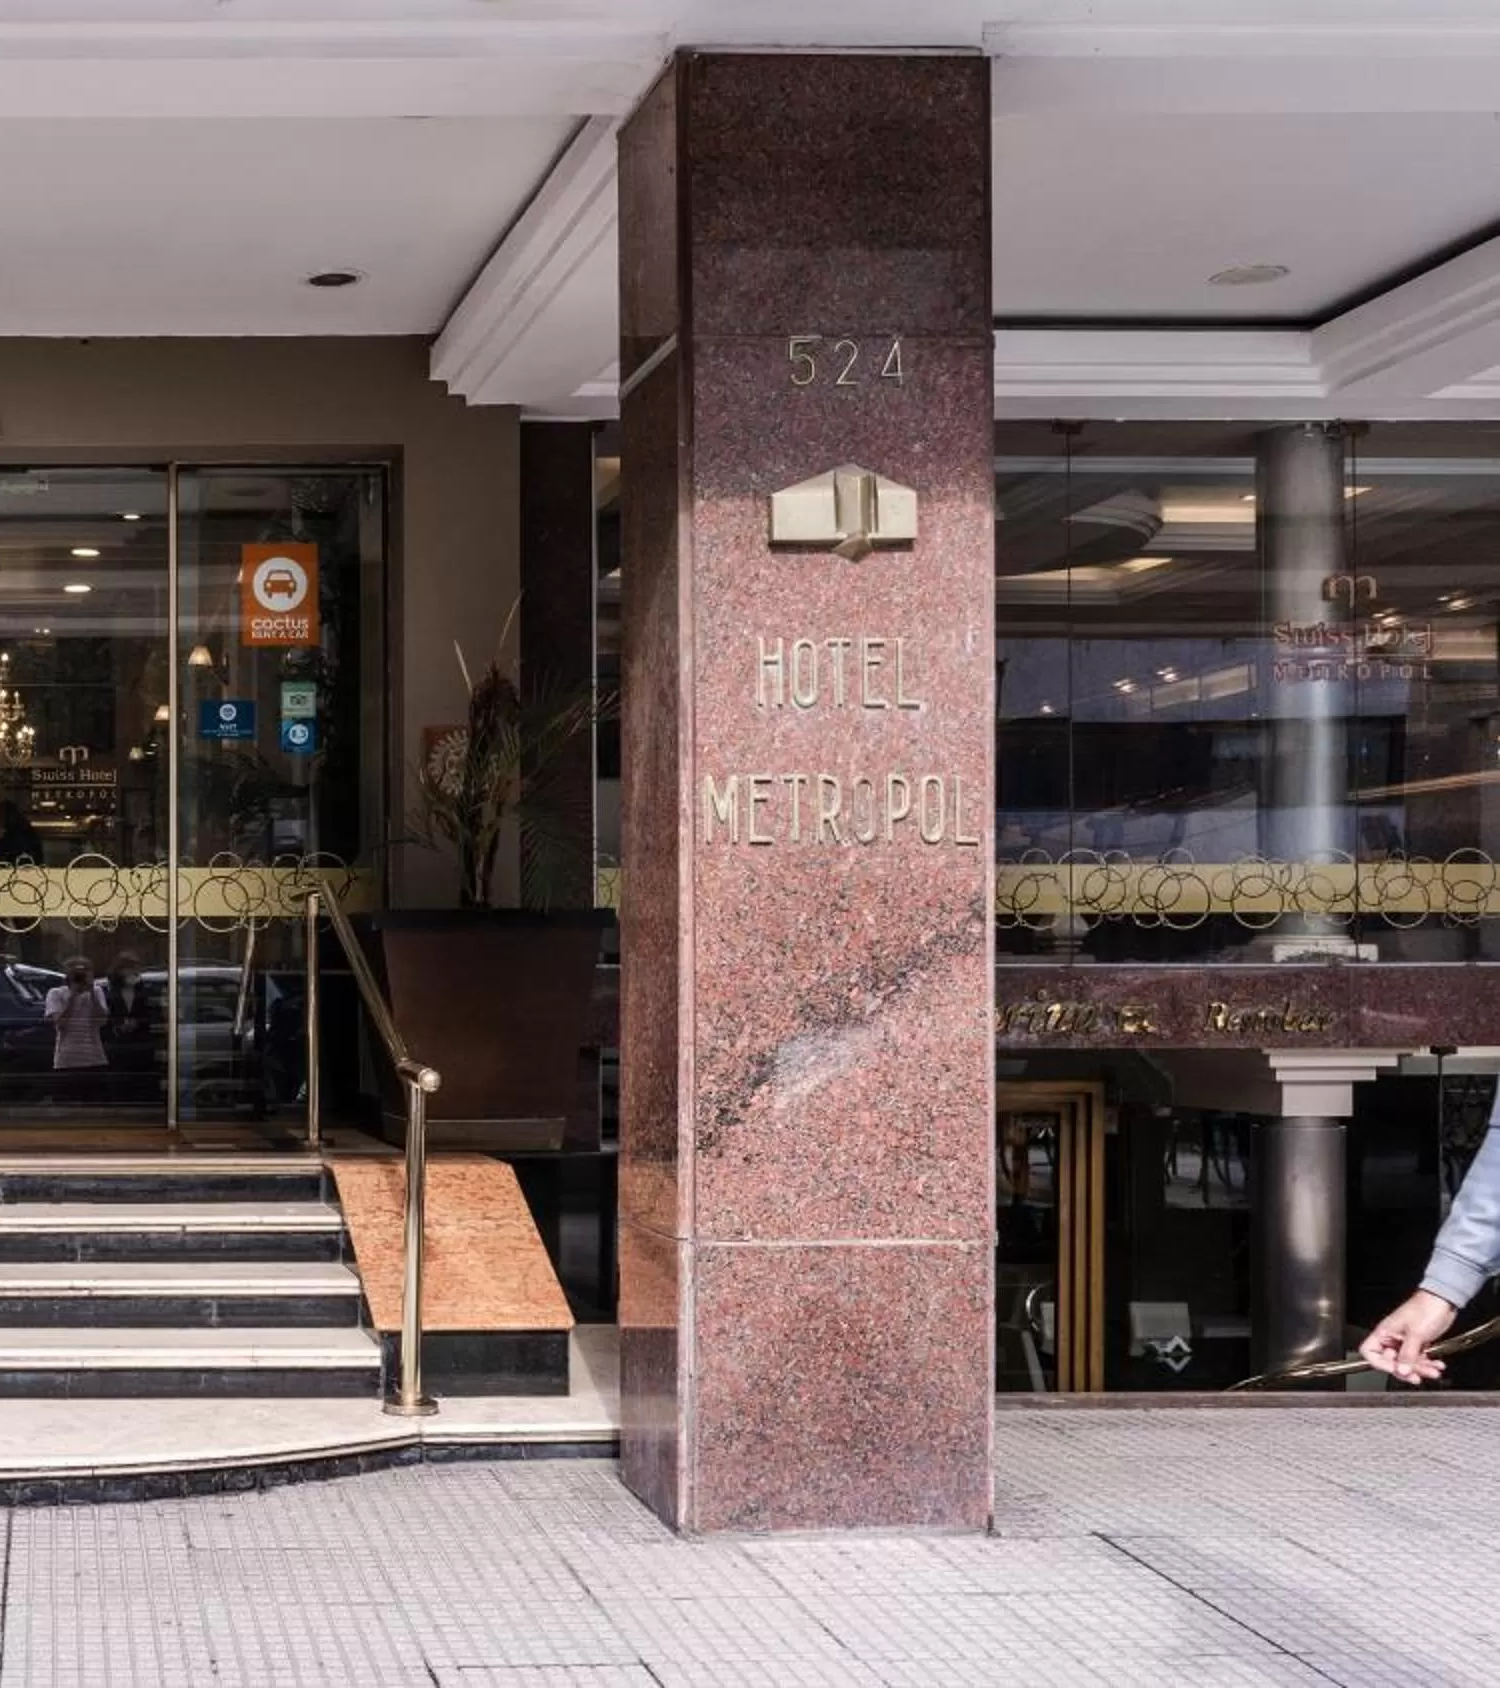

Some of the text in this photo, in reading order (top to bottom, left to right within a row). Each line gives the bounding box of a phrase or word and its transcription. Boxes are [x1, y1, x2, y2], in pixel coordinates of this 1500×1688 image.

[788, 335, 904, 385] 524
[251, 616, 309, 630] cactus
[1273, 620, 1433, 653] Swiss Hotel
[756, 636, 922, 710] HOTEL
[31, 768, 117, 783] Swiss Hotel
[704, 773, 980, 847] METROPOL
